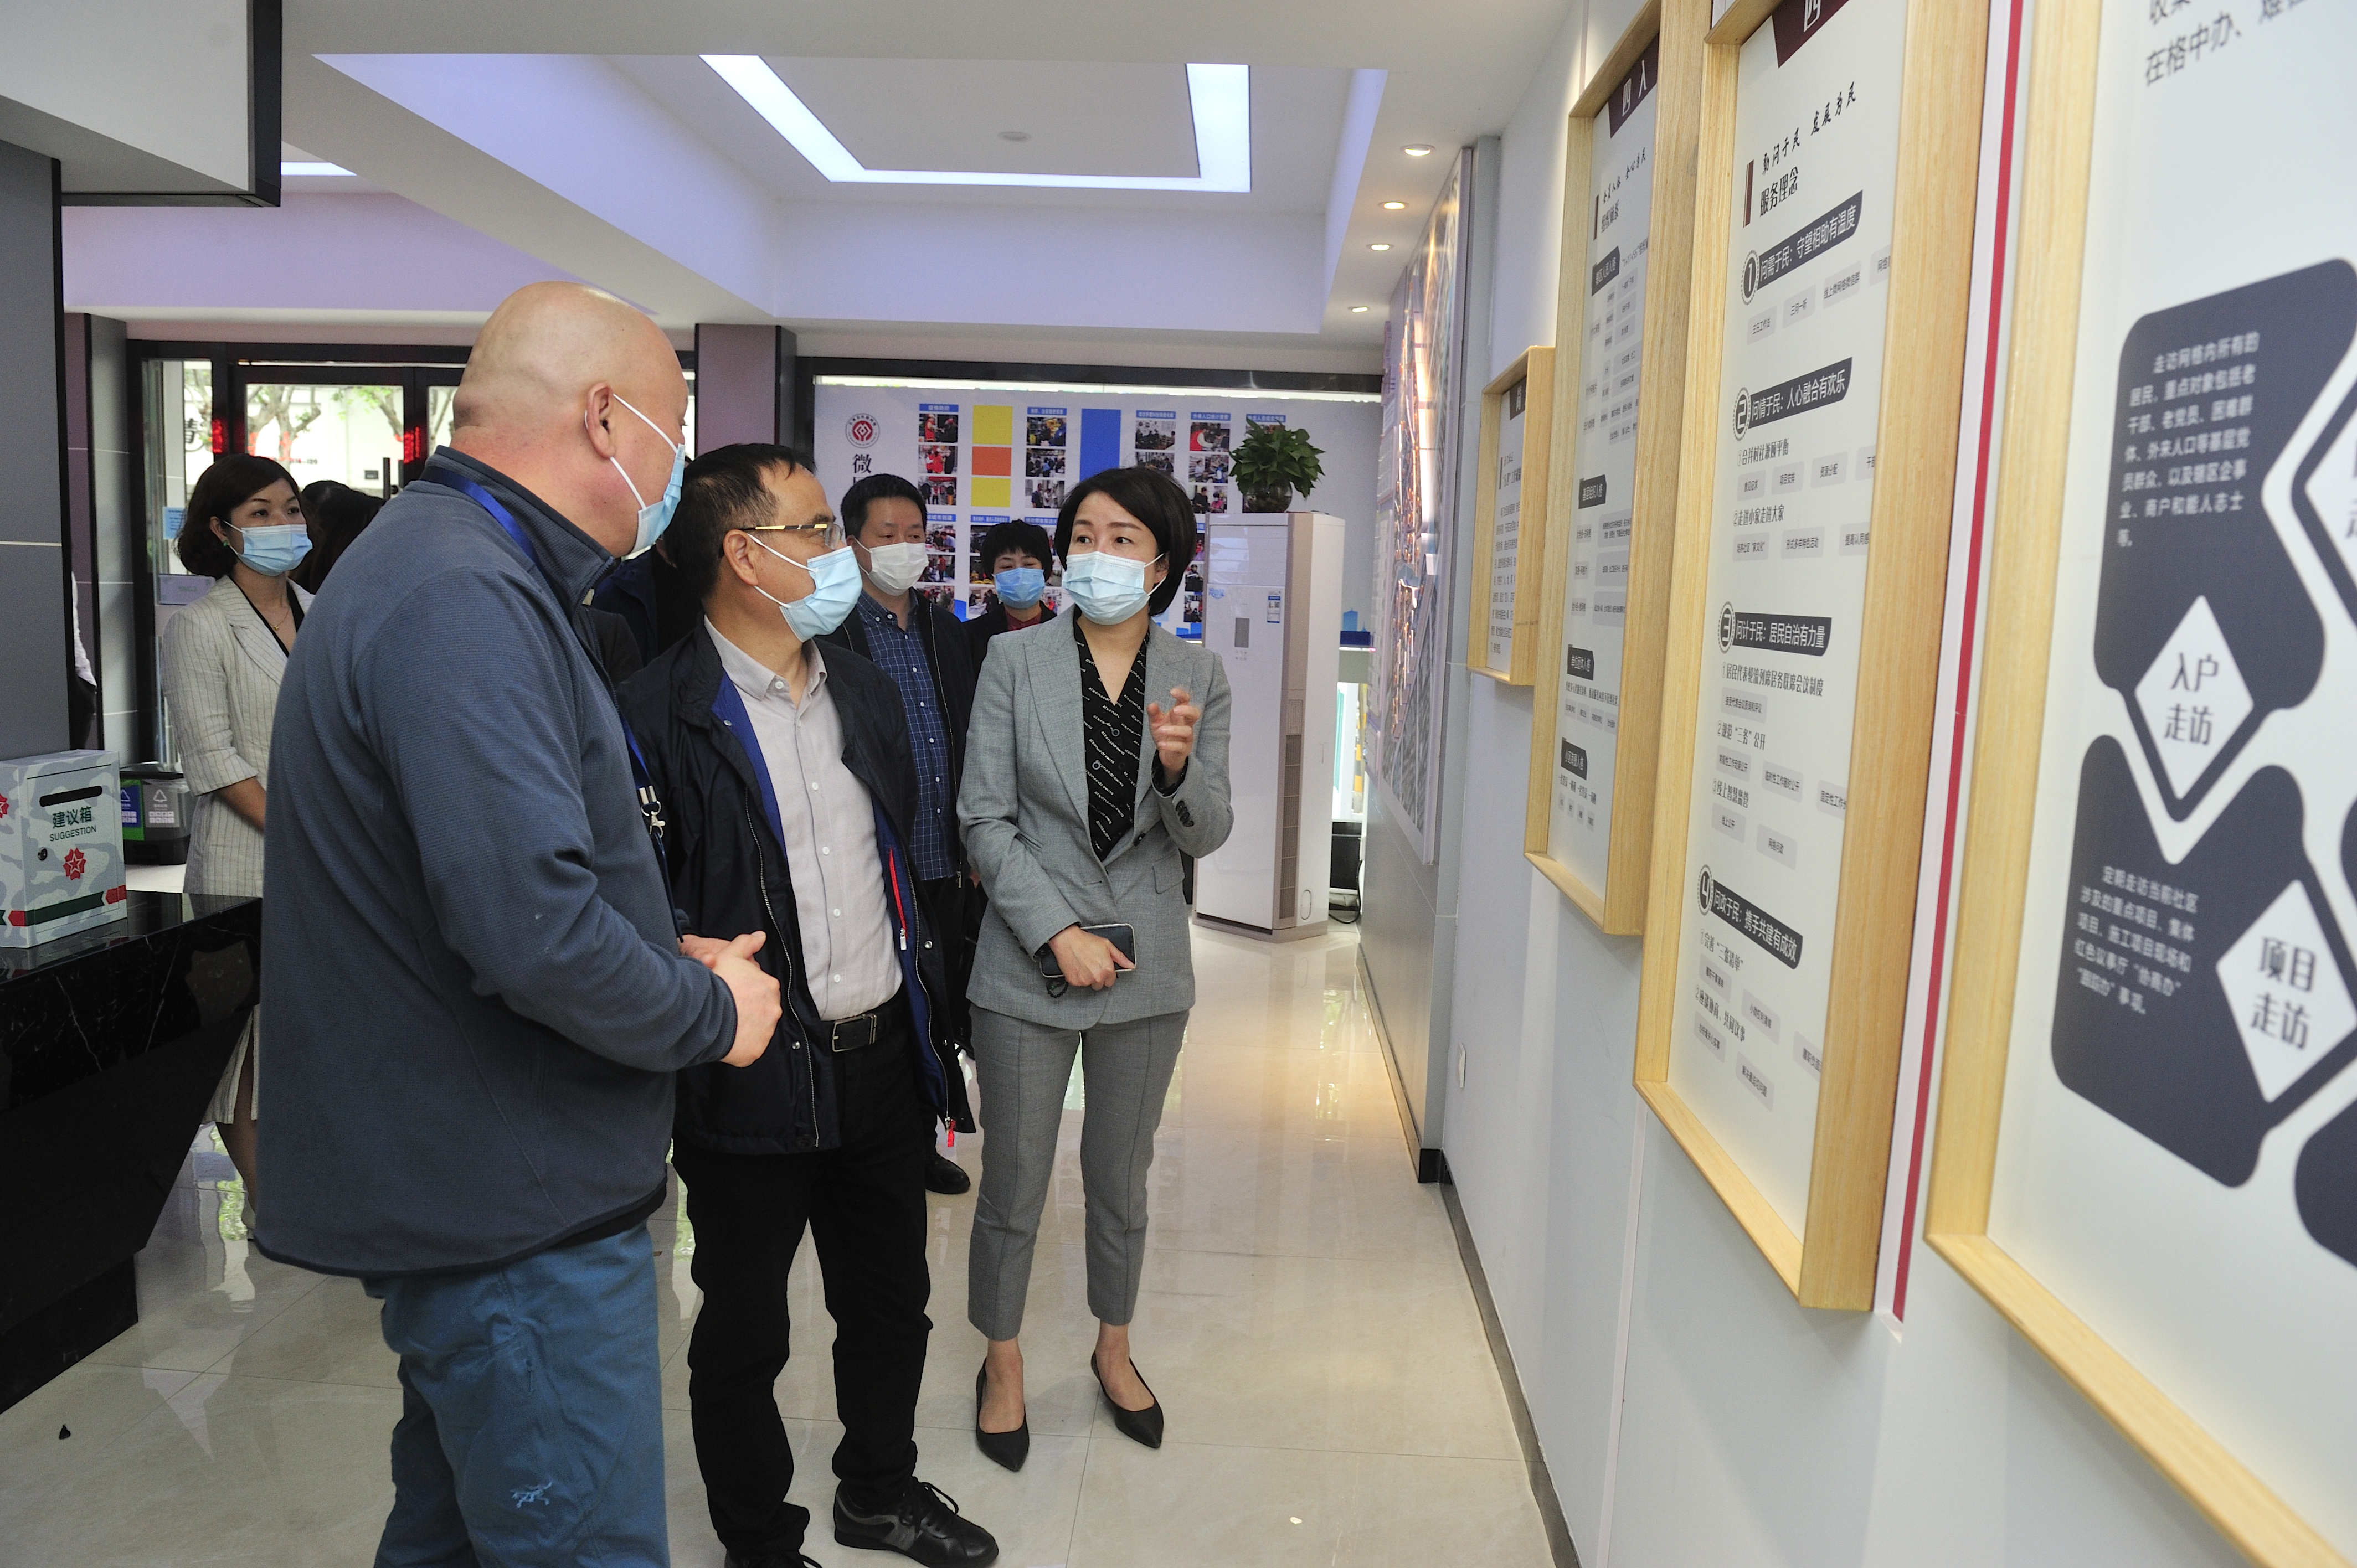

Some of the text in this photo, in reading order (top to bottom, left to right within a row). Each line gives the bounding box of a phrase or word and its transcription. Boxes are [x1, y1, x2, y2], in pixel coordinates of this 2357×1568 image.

[1760, 166, 1799, 217] 服务理念
[1735, 620, 1826, 649] 问计于民：居民自治有力量
[2170, 652, 2220, 693] 入户
[2163, 703, 2215, 746] 走访
[49, 825, 96, 842] SUGGESTION
[52, 806, 92, 829] 建议箱
[1714, 889, 1799, 963] 问政于民：携手共建有成效
[2258, 936, 2316, 993] 项目
[2250, 992, 2310, 1050] 走访
